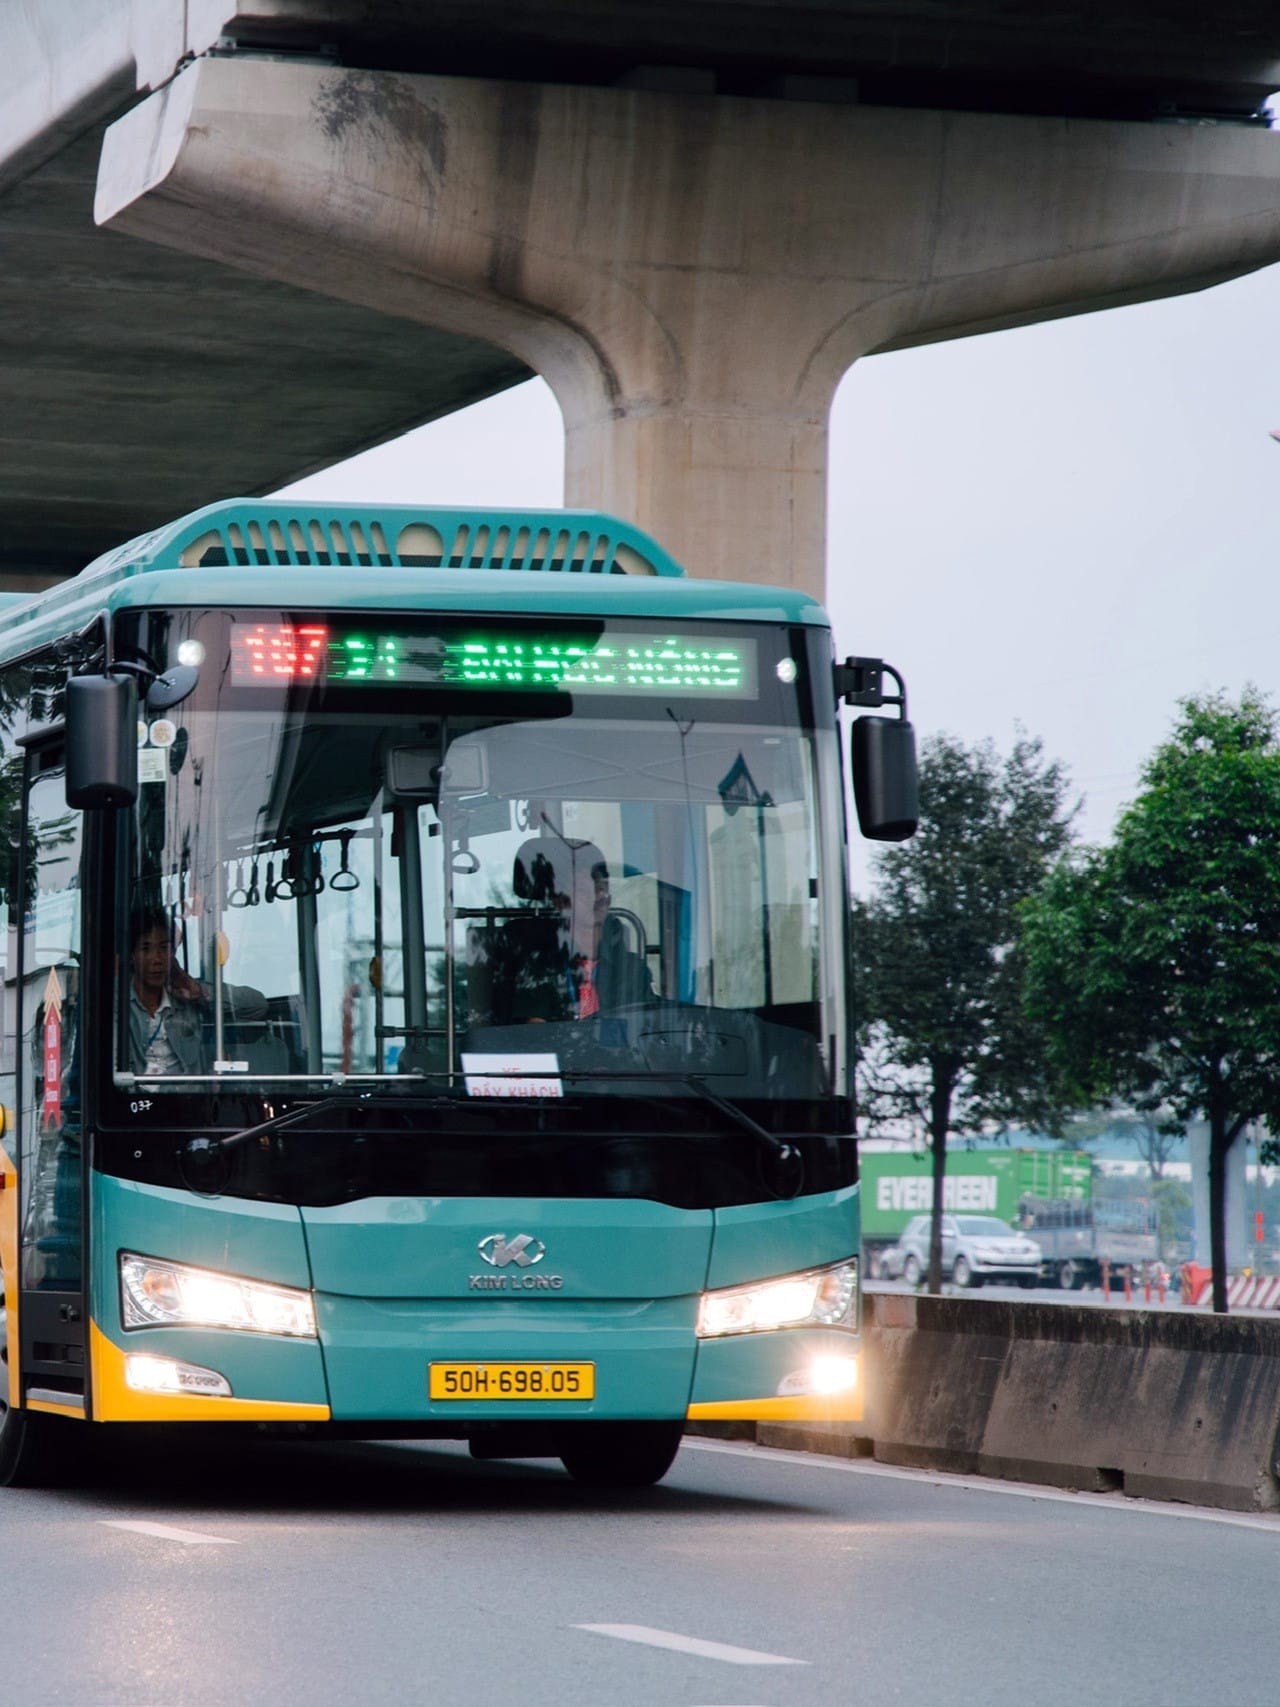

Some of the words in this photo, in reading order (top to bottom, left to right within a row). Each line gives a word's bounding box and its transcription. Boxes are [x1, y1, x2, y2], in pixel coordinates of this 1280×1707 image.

[877, 1175, 998, 1211] EVERREEN
[469, 1275, 506, 1290] KIM
[511, 1275, 563, 1290] LONG
